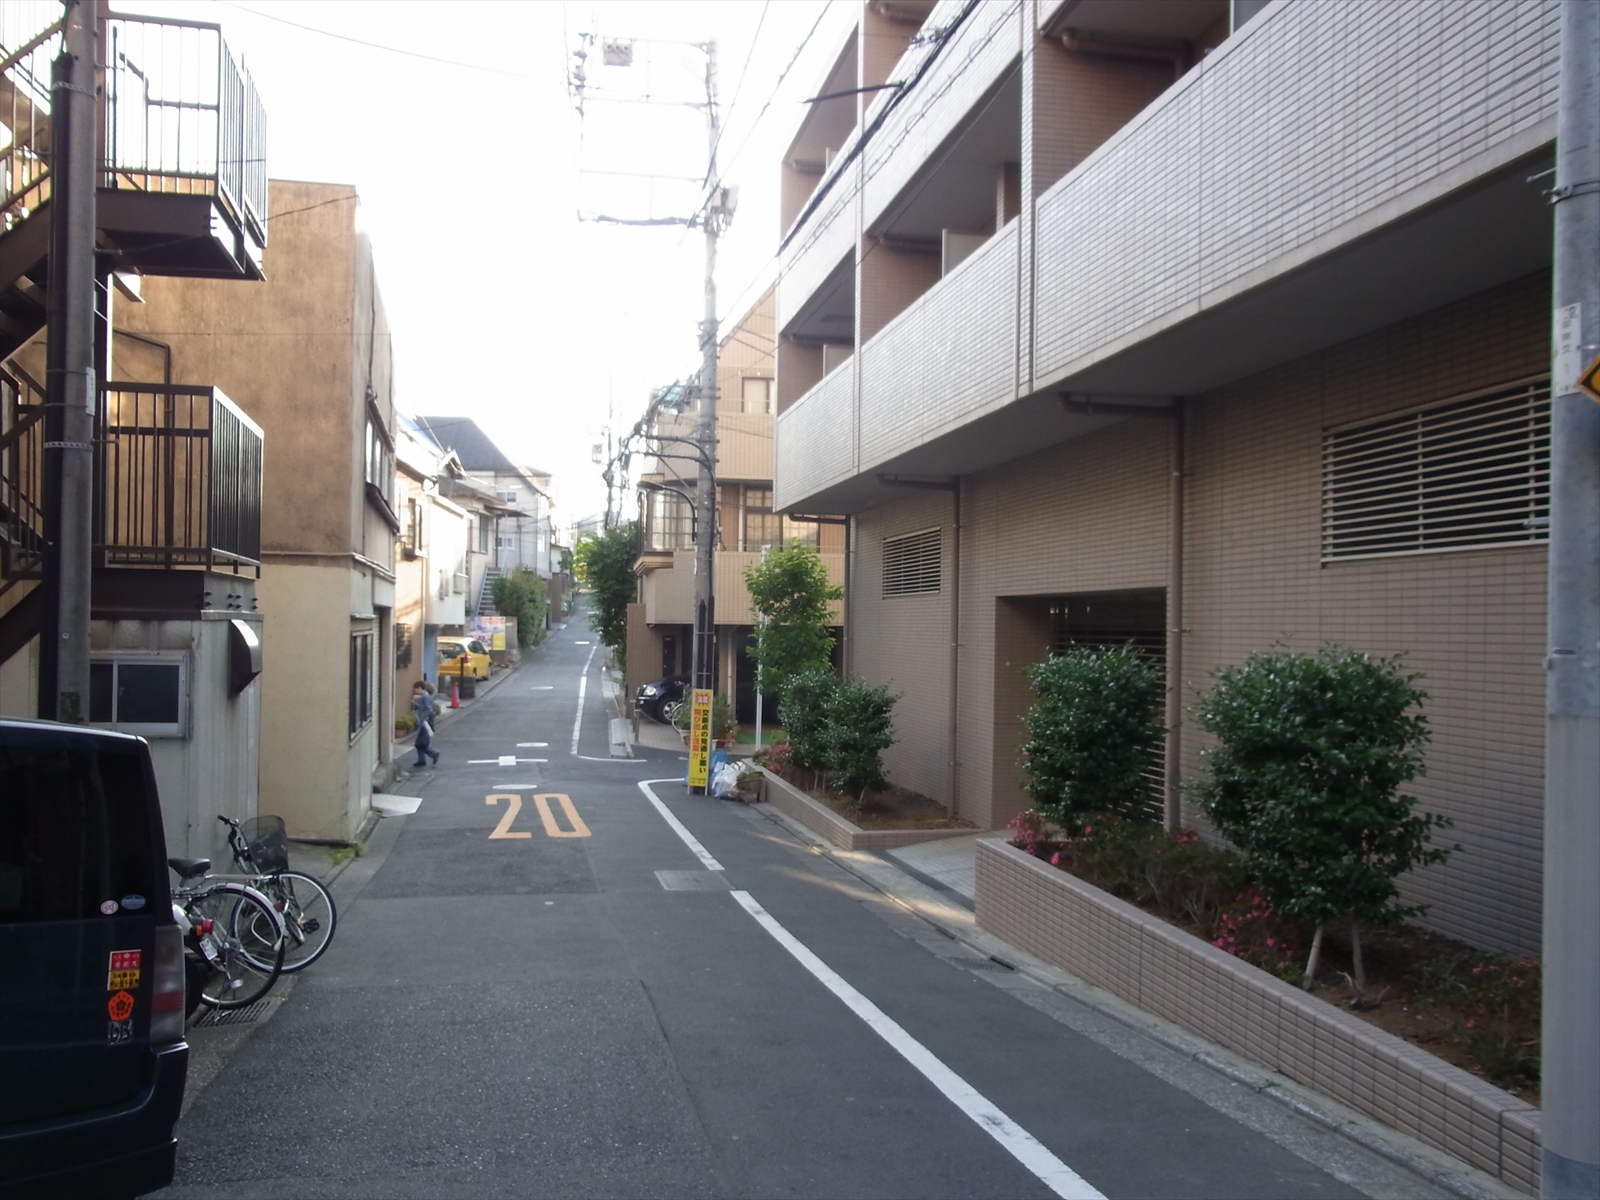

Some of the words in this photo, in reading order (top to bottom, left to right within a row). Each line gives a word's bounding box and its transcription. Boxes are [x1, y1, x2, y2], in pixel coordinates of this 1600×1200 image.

[692, 709, 701, 759] び出し注!!
[486, 793, 591, 839] 20
